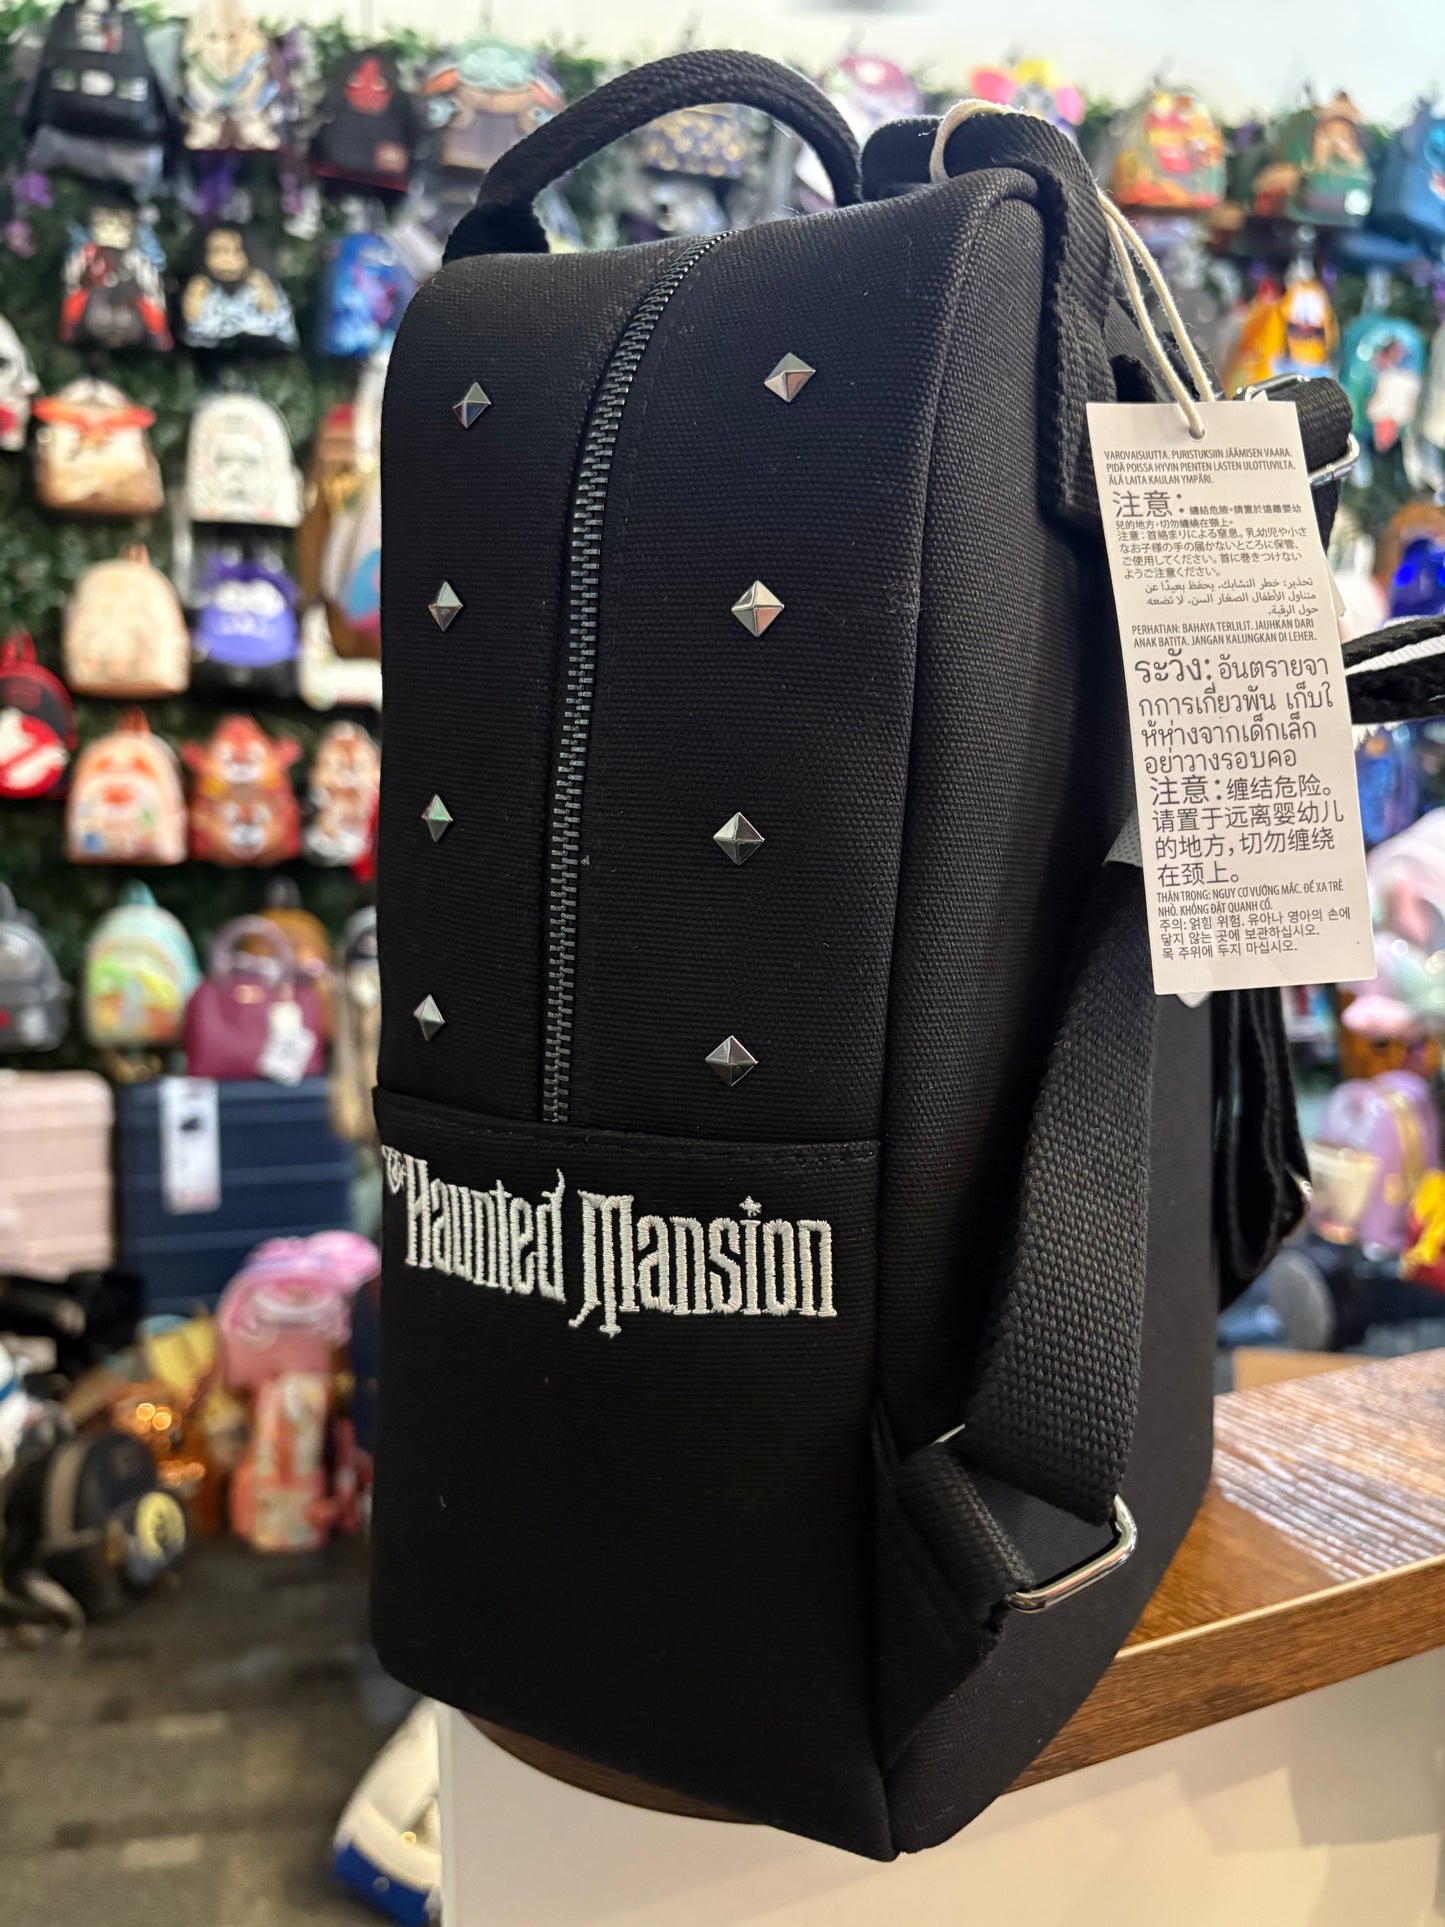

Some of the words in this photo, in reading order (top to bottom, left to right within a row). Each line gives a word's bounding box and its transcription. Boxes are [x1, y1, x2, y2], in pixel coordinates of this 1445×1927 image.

[1104, 450, 1171, 460] VAROVAISUUTTA.
[1171, 449, 1223, 460] PURISTUKSIIN
[1225, 447, 1263, 458] JÄÄMISEN
[1263, 448, 1293, 457] VAARA.
[1106, 462, 1125, 472] PIDÄ
[1126, 463, 1154, 472] POISSA
[1154, 462, 1179, 472] HYVIN
[1180, 462, 1212, 472] PIENTEN
[1213, 461, 1242, 471] LASTEN
[1243, 460, 1296, 470] ULOTTUVILTA.
[1108, 474, 1124, 485] ÄLÄ
[1125, 475, 1148, 485] LAITA
[1148, 475, 1180, 485] KAULAN
[1181, 473, 1214, 484] YMPÄRI.
[1145, 584, 1159, 594] عن
[1188, 580, 1215, 592] يحفظ
[1259, 577, 1280, 590] خطر
[1176, 594, 1184, 605] لا
[1217, 592, 1249, 605] الصغار
[1288, 590, 1316, 602] متناول
[1298, 604, 1318, 616] حول
[1131, 623, 1181, 635] PERHATIAN:
[1182, 622, 1216, 633] BAHAYA
[1216, 620, 1254, 632] TERLILIT.
[1255, 619, 1293, 630] JAUHKAN
[1294, 618, 1314, 628] DARI
[1134, 637, 1157, 648] ANAK
[1158, 636, 1190, 647] BATITA.
[1191, 634, 1224, 646] JANGAN
[1226, 632, 1277, 644] KALUNGKAN
[1278, 632, 1287, 641] DI
[1288, 631, 1317, 641] LEHER.
[1152, 799, 1344, 833] 请置于远离婴幼儿
[1157, 860, 1239, 888] 在颈上。
[1212, 887, 1236, 899] NGUY
[1316, 881, 1327, 893] XA
[1227, 901, 1258, 913] QUANH
[1160, 918, 1187, 932] 주의:
[1217, 914, 1245, 928] 위험.
[1248, 911, 1284, 926] 유아나
[1287, 908, 1323, 922] 영아의
[1327, 906, 1351, 920] 손에
[1161, 932, 1184, 946] 닿지
[1188, 931, 1212, 945] 않는
[1216, 928, 1240, 943] 곳에
[1245, 924, 1320, 940] 보관하십시오.
[1162, 947, 1174, 961] 목
[1178, 945, 1213, 960] 주위에
[1217, 942, 1241, 957] 두지
[1246, 939, 1298, 955] 마십시오.
[404, 1152, 566, 1303] Haunted
[568, 1189, 838, 1337] Mansion
